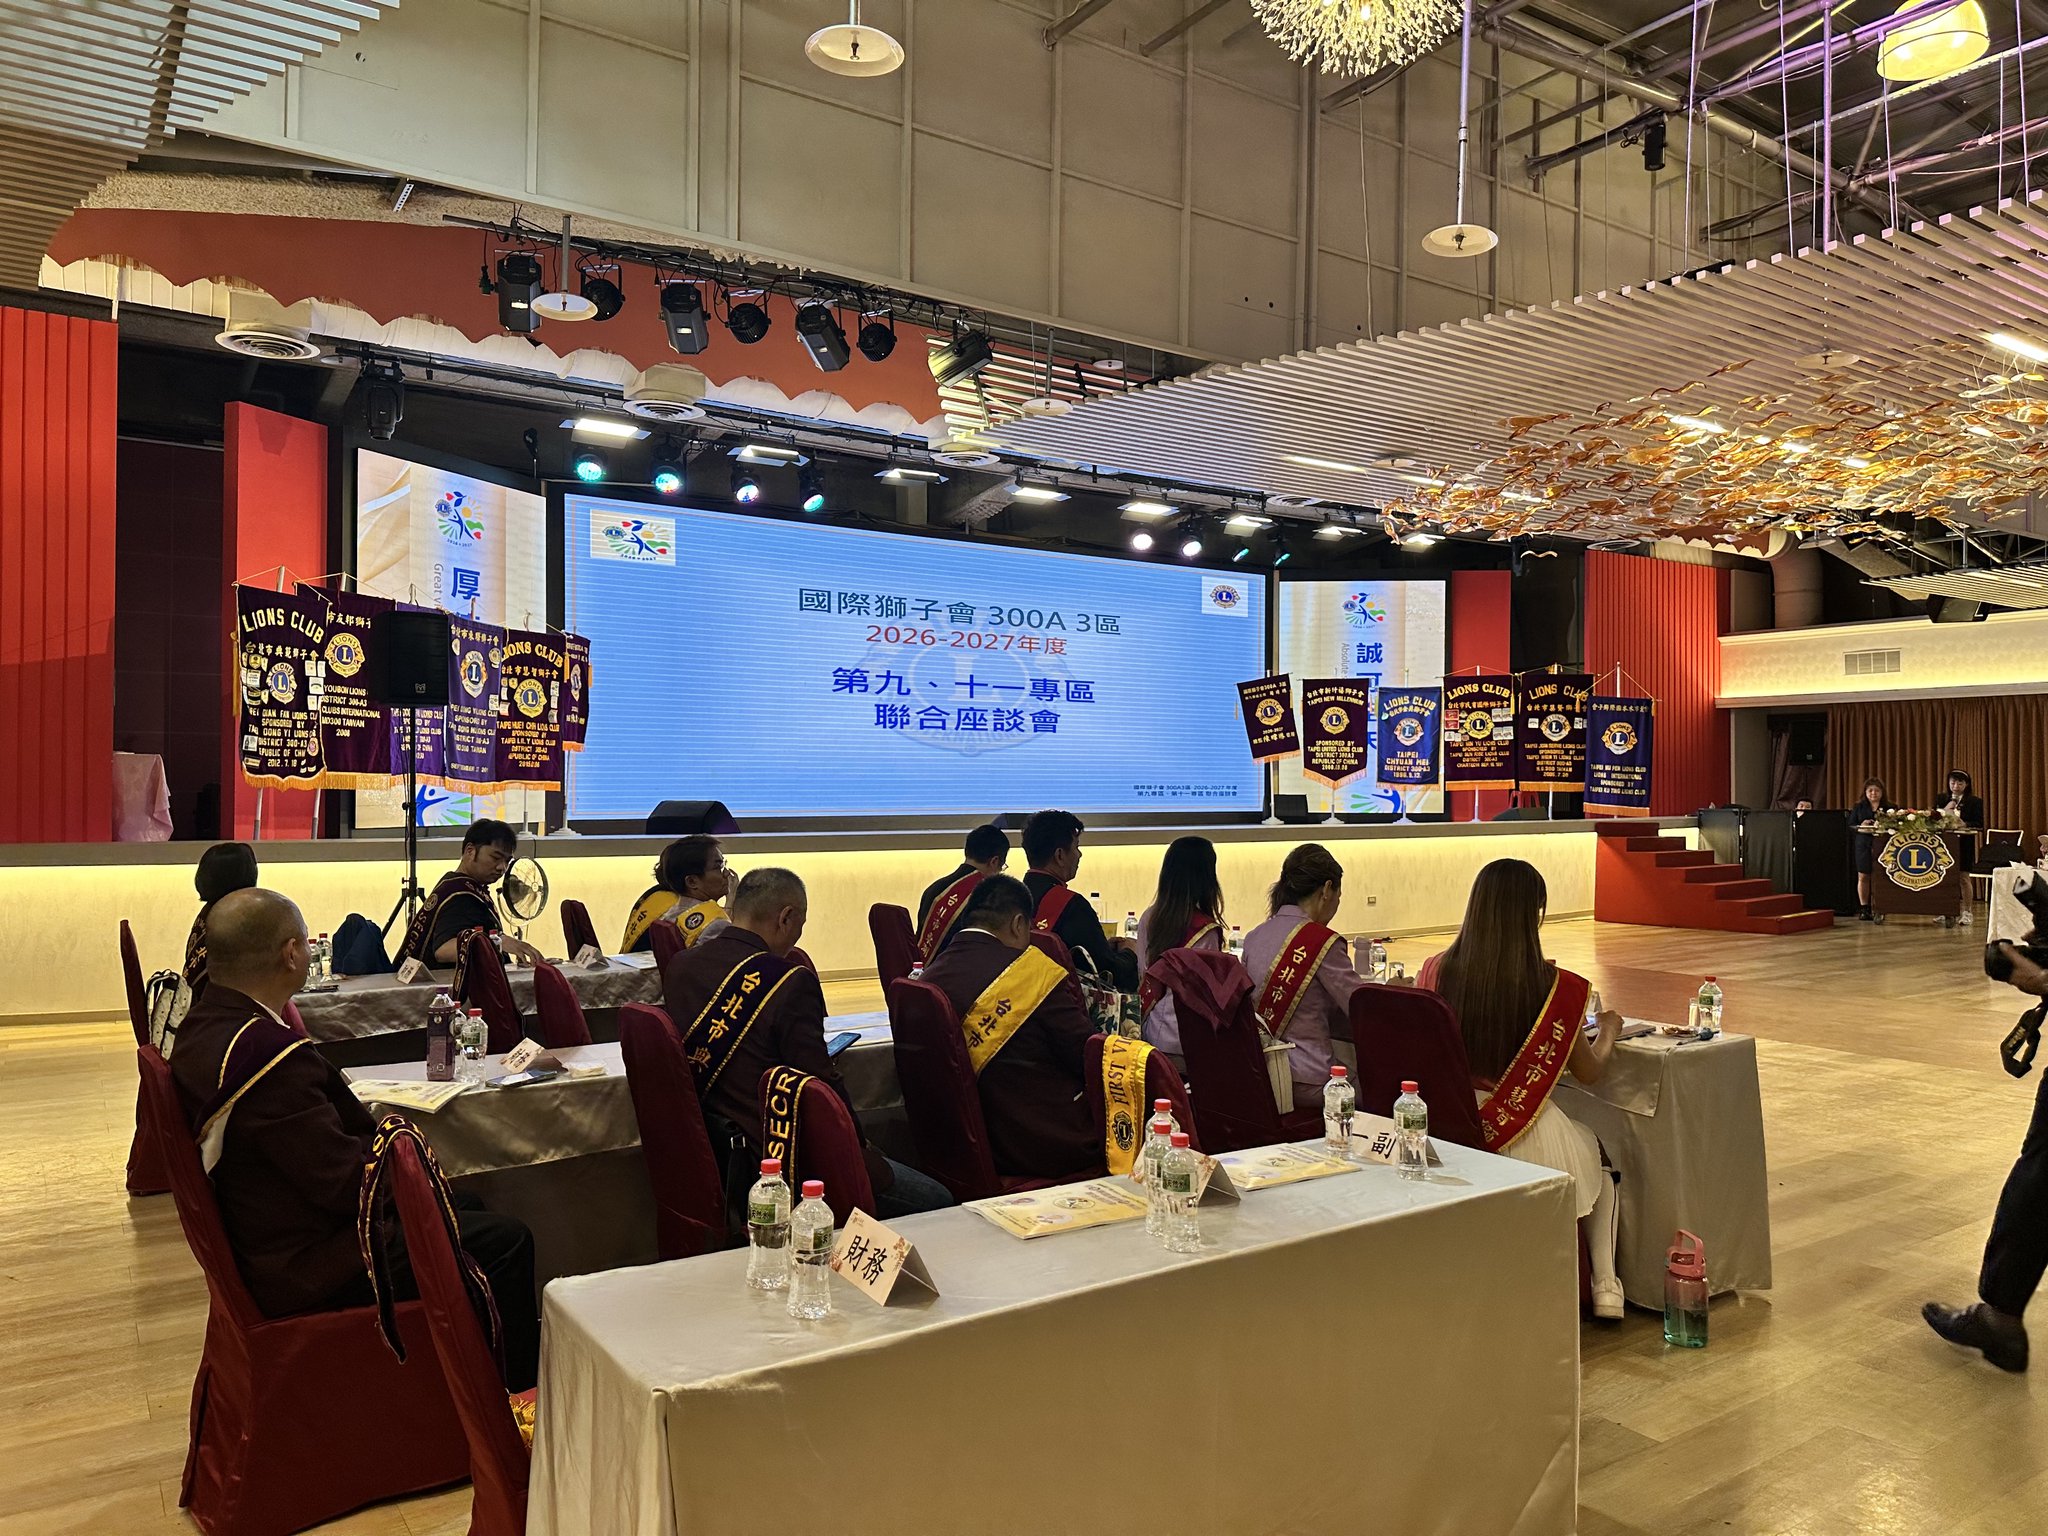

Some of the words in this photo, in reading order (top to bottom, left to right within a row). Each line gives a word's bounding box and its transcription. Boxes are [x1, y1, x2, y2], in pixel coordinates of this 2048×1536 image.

[433, 564, 444, 591] Great
[798, 587, 978, 626] 國際獅子會
[988, 605, 1067, 631] 300A
[1077, 614, 1121, 635] 3區
[242, 607, 285, 633] LIONS
[290, 611, 324, 644] CLUB
[866, 625, 1068, 656] 2026-2027年度
[342, 647, 351, 662] L
[534, 643, 564, 668] CLUB
[278, 675, 286, 690] L
[831, 667, 1096, 705] 第九、十一專區
[527, 691, 536, 705] L
[1446, 683, 1479, 700] LIONS
[1482, 683, 1510, 698] CLUB
[1529, 683, 1558, 700] LIONS
[1383, 695, 1410, 711] LIONS
[1412, 695, 1437, 711] CLUB
[874, 703, 1061, 734] 聯合座談會
[1332, 715, 1339, 725] L
[1476, 720, 1484, 730] L
[1551, 722, 1560, 732] L
[1614, 732, 1625, 745] L
[259, 748, 280, 757] EPUBLIC
[1895, 832, 1937, 846] LIONS
[1908, 848, 1927, 869] L
[1896, 873, 1937, 885] INTERNATIONAL
[967, 998, 1012, 1049] 台北市
[1107, 1061, 1130, 1106] FIRST
[842, 1234, 888, 1287] 財務
